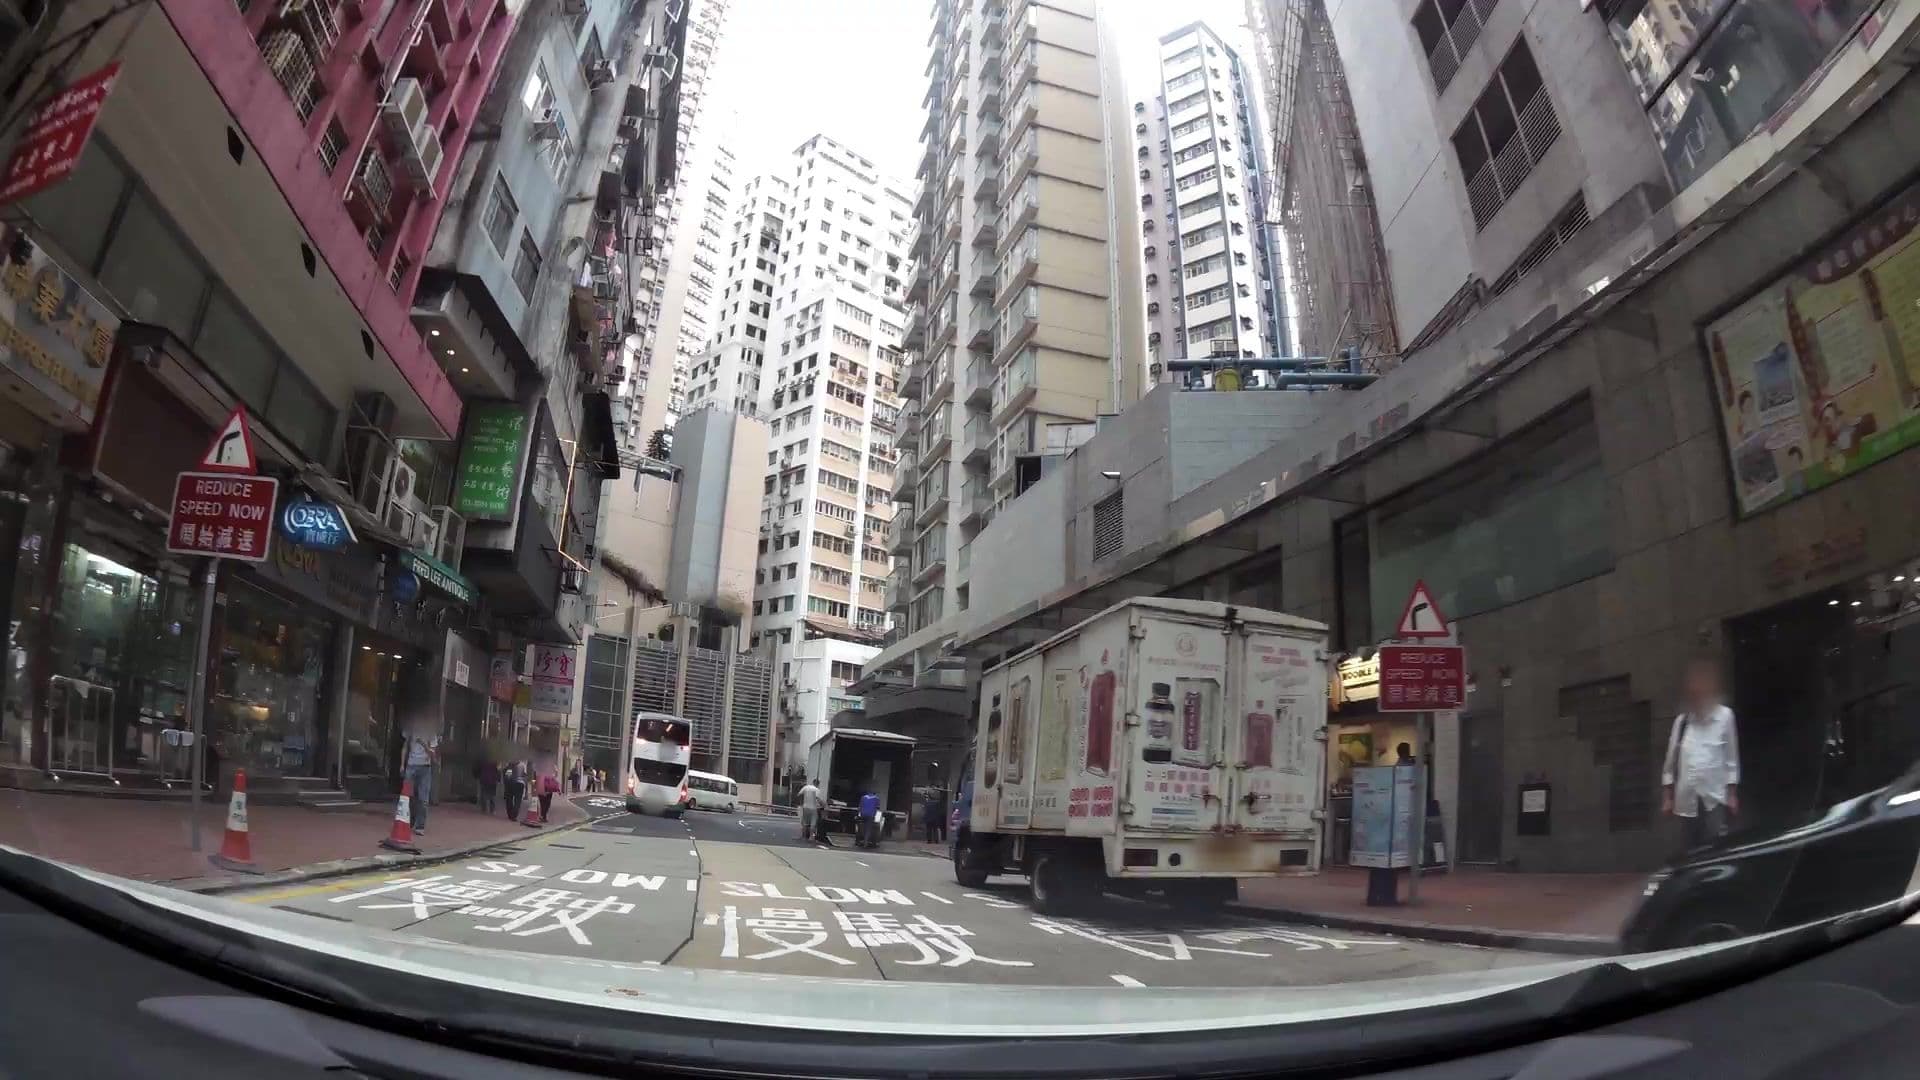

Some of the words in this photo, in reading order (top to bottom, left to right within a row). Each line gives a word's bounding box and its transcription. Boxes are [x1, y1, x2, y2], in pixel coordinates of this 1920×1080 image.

[196, 480, 253, 498] REDUCE
[179, 499, 223, 517] SPEED
[228, 503, 265, 521] NOW
[283, 502, 341, 533] COBRA
[179, 522, 256, 552] 開始減速
[412, 558, 430, 580] FRED
[431, 569, 442, 588] LEE
[441, 576, 469, 602] ANTIQUE
[1399, 652, 1447, 664] REDUCE
[1386, 668, 1425, 679] SPEED
[1431, 668, 1459, 679] NOW
[466, 860, 667, 891] SLOW
[720, 881, 916, 906] SLOW
[328, 875, 637, 945] 慢駛
[703, 905, 1034, 967] 慢駛
